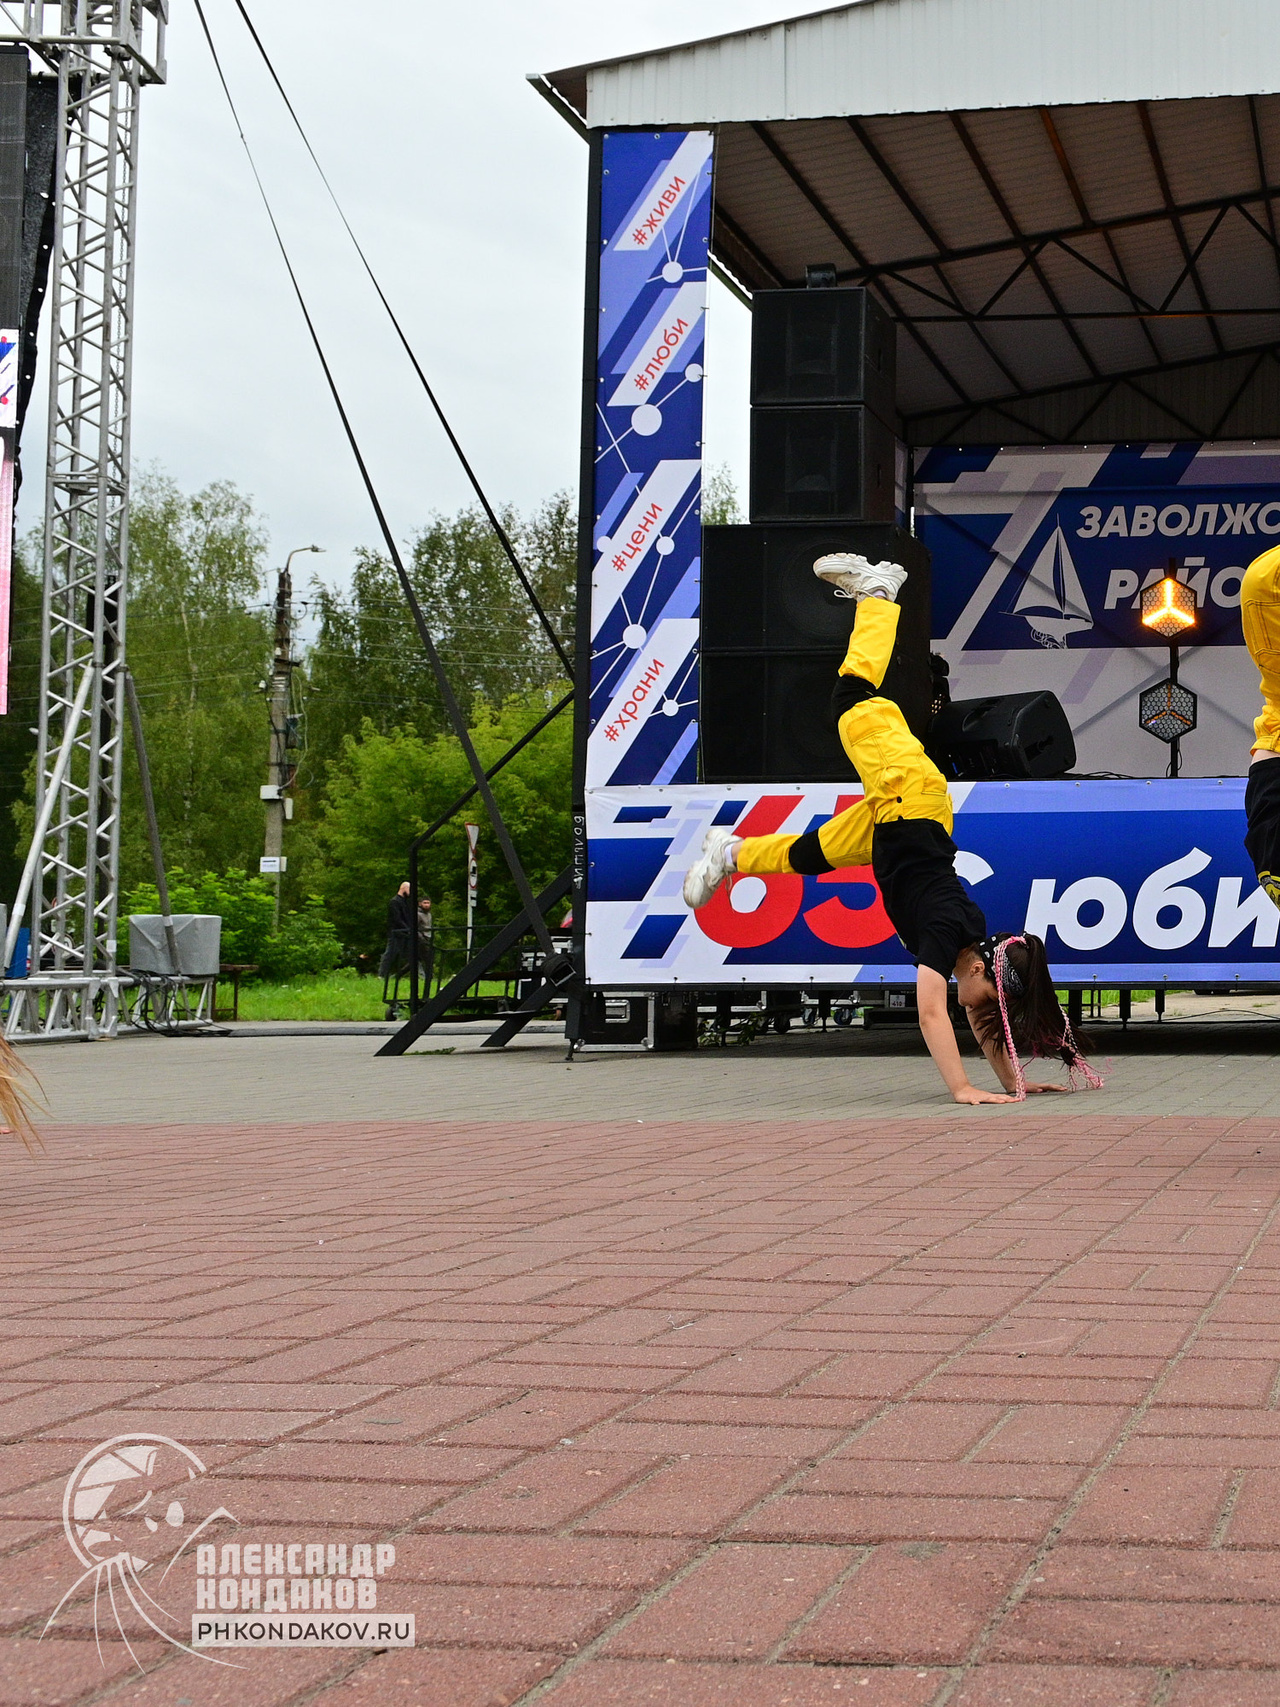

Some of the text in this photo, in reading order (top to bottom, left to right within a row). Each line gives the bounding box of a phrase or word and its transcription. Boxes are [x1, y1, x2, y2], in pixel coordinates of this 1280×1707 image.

[632, 176, 686, 245] #живи
[634, 318, 689, 391] #люби
[611, 503, 663, 572] #цени
[604, 659, 665, 742] #храни
